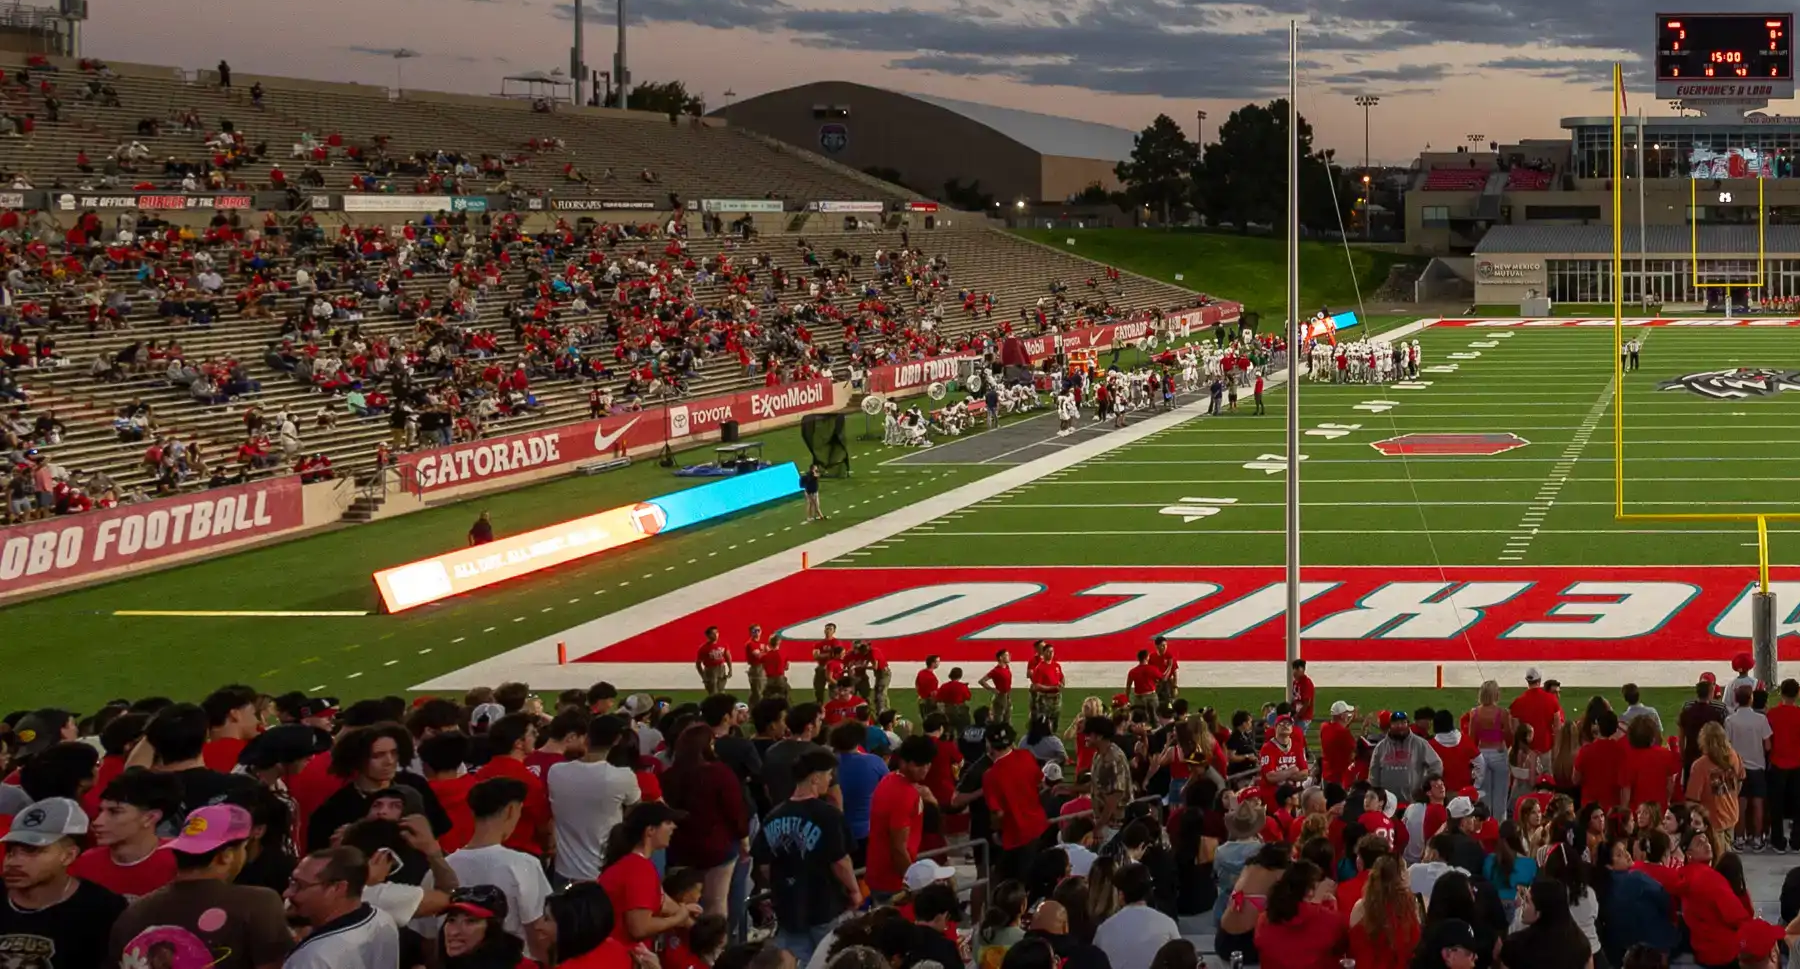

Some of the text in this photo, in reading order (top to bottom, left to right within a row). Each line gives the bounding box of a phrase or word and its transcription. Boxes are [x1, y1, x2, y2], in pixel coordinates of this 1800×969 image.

[1711, 52, 1741, 63] 15:00
[1676, 85, 1735, 96] EVERYONE'S
[1747, 85, 1772, 95] LOBO
[81, 197, 98, 206] THE
[100, 197, 136, 207] OFFICIAL
[138, 195, 186, 209] BURGER
[557, 200, 601, 210] FLOORSCAPES
[1512, 263, 1540, 271] MEXICO
[895, 363, 921, 388] LOBO
[751, 382, 822, 418] ExxonMobil
[691, 405, 732, 425] TOYOTA
[415, 433, 560, 488] GATORADE
[0, 490, 271, 580] OBO FOOTBALL
